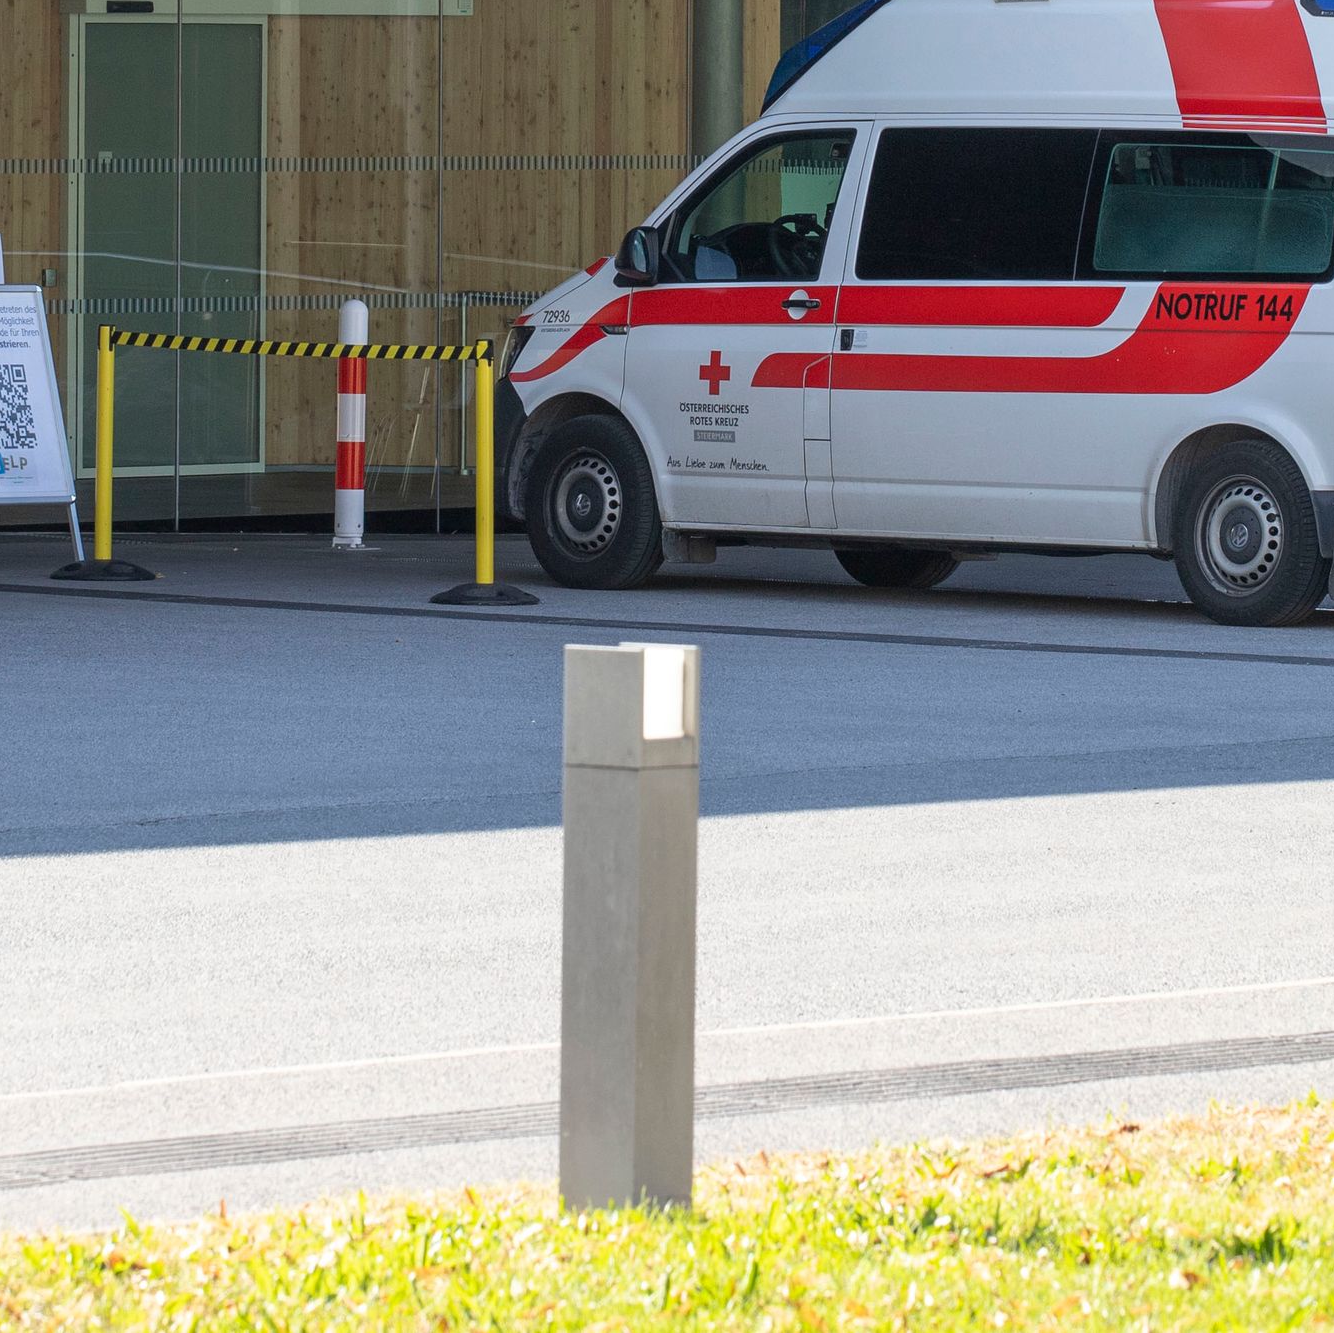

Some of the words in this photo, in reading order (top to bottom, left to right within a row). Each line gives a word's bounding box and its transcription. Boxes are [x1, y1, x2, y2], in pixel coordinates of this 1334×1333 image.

[24, 305, 37, 314] des
[1155, 292, 1248, 321] NOTRUF
[1255, 294, 1294, 321] 144
[542, 309, 571, 323] 72936
[10, 329, 20, 337] für
[21, 329, 40, 337] Ihren
[679, 401, 750, 414] ÖSTERREICHISCHES
[689, 416, 713, 426] ROTES
[714, 417, 739, 427] KREUZ
[666, 455, 682, 467] Aus
[685, 455, 707, 469] Liebe
[709, 461, 725, 469] zum
[729, 457, 770, 472] Menschen.
